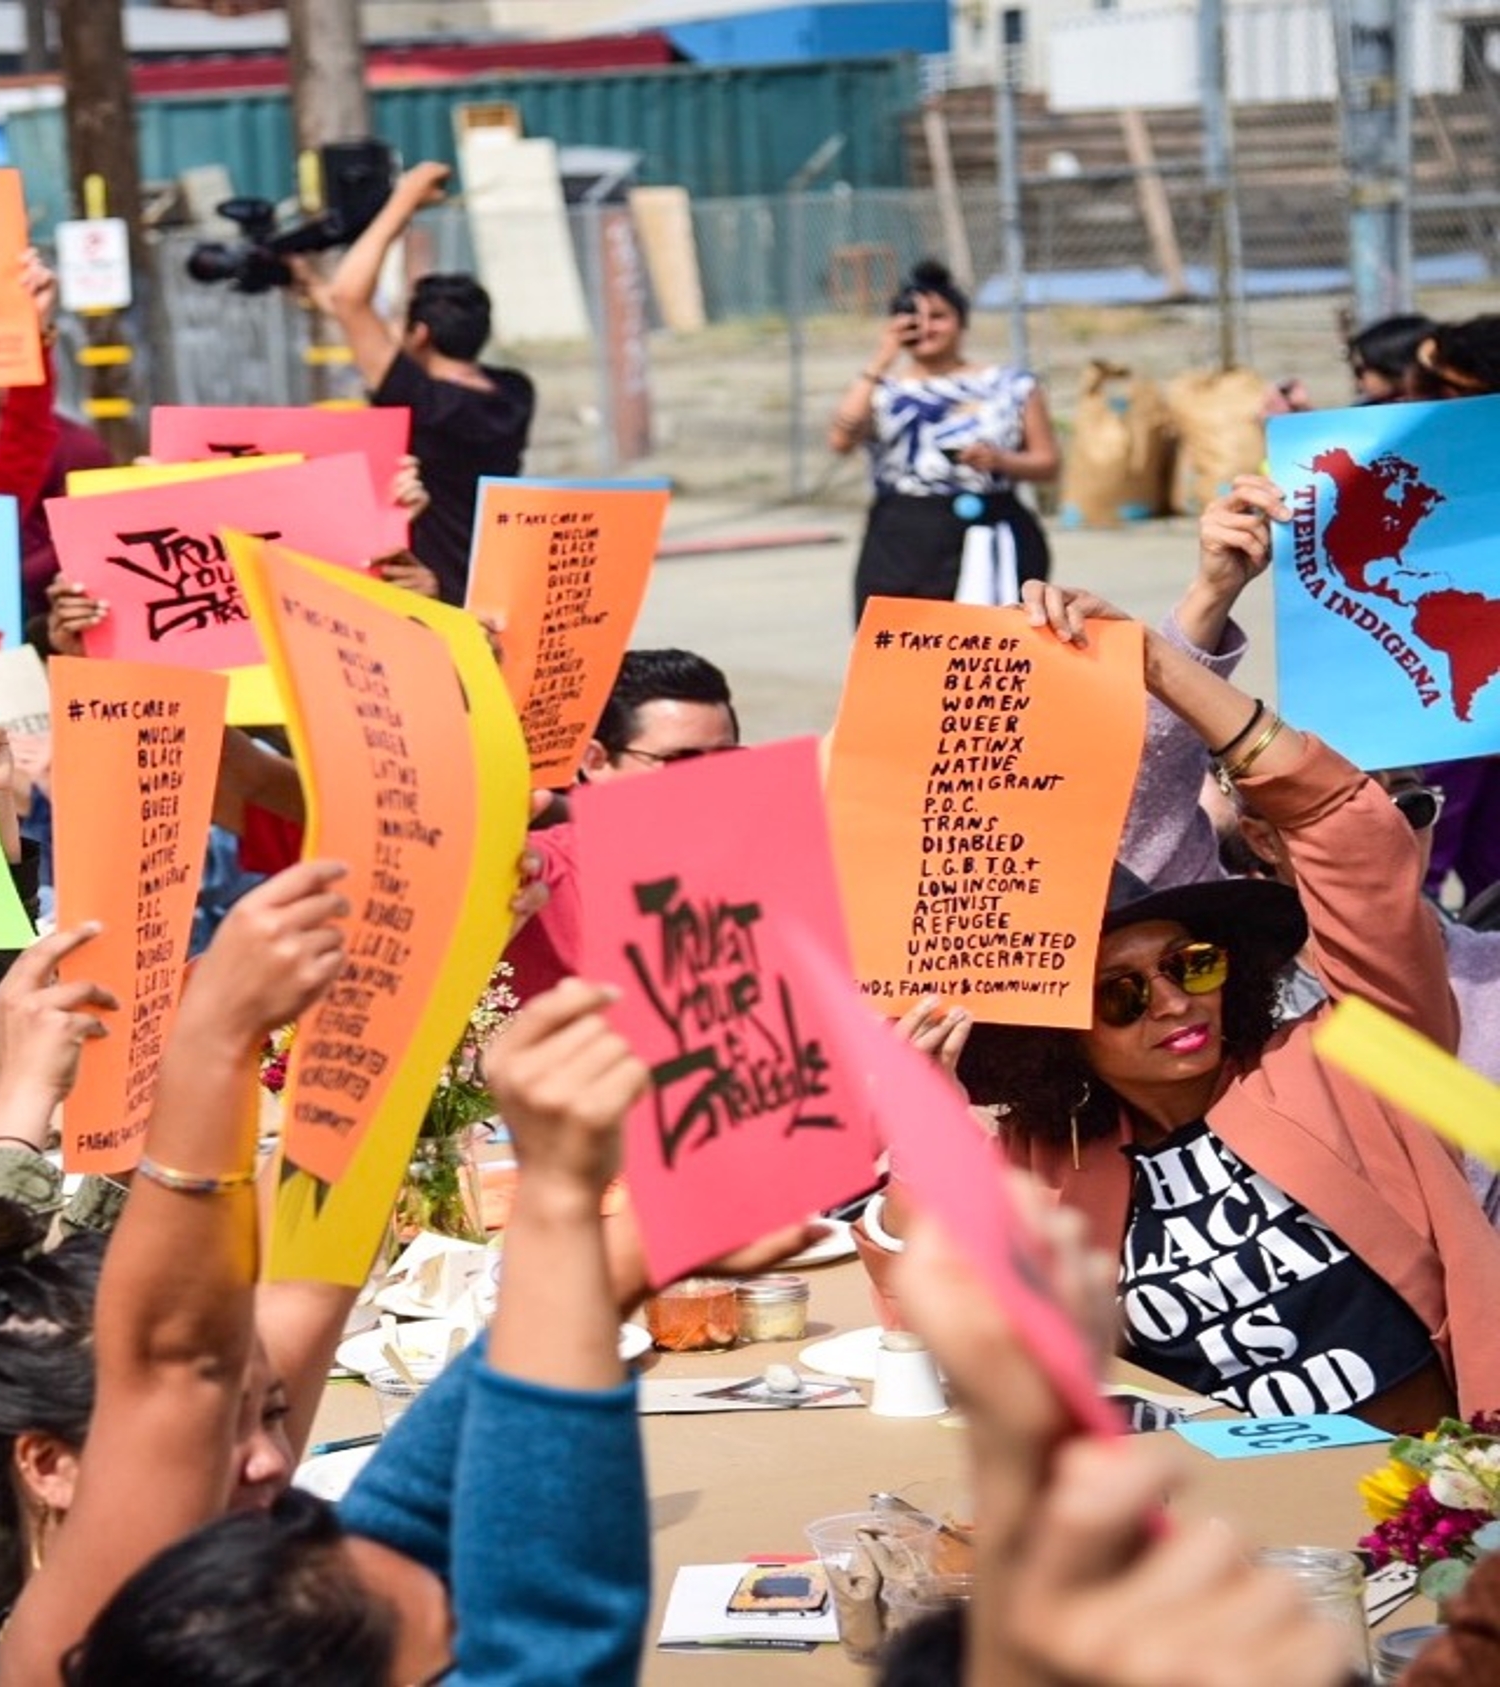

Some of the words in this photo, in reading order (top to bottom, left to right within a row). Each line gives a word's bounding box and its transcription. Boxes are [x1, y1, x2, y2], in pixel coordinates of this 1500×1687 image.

[549, 541, 595, 555] BLACK
[1293, 485, 1327, 599] TIERRA
[1323, 590, 1441, 708] INDIGENA
[948, 634, 991, 651] CARE
[998, 637, 1020, 651] OF
[946, 657, 1031, 675] MUSLIM
[944, 674, 1026, 692] BLACK
[132, 700, 165, 719] CARE
[941, 696, 1030, 712] WOMEN
[940, 715, 1019, 735] QUEER
[937, 737, 1024, 755] LATINX
[138, 747, 182, 768] BLACK
[931, 755, 1018, 776] NATIVE
[138, 771, 184, 795] WOMEN
[927, 774, 1065, 795] IMMIGRANT
[922, 816, 999, 833] TRANS
[922, 834, 1025, 853] DISABLED
[914, 896, 1002, 915] ACTIVIST
[913, 913, 1010, 935] REFUGEE
[908, 932, 1077, 956] UNDOCUMENTED
[908, 952, 1066, 974] INCARCERATED
[1196, 1304, 1299, 1380] IS
[1209, 1347, 1376, 1417] OD
